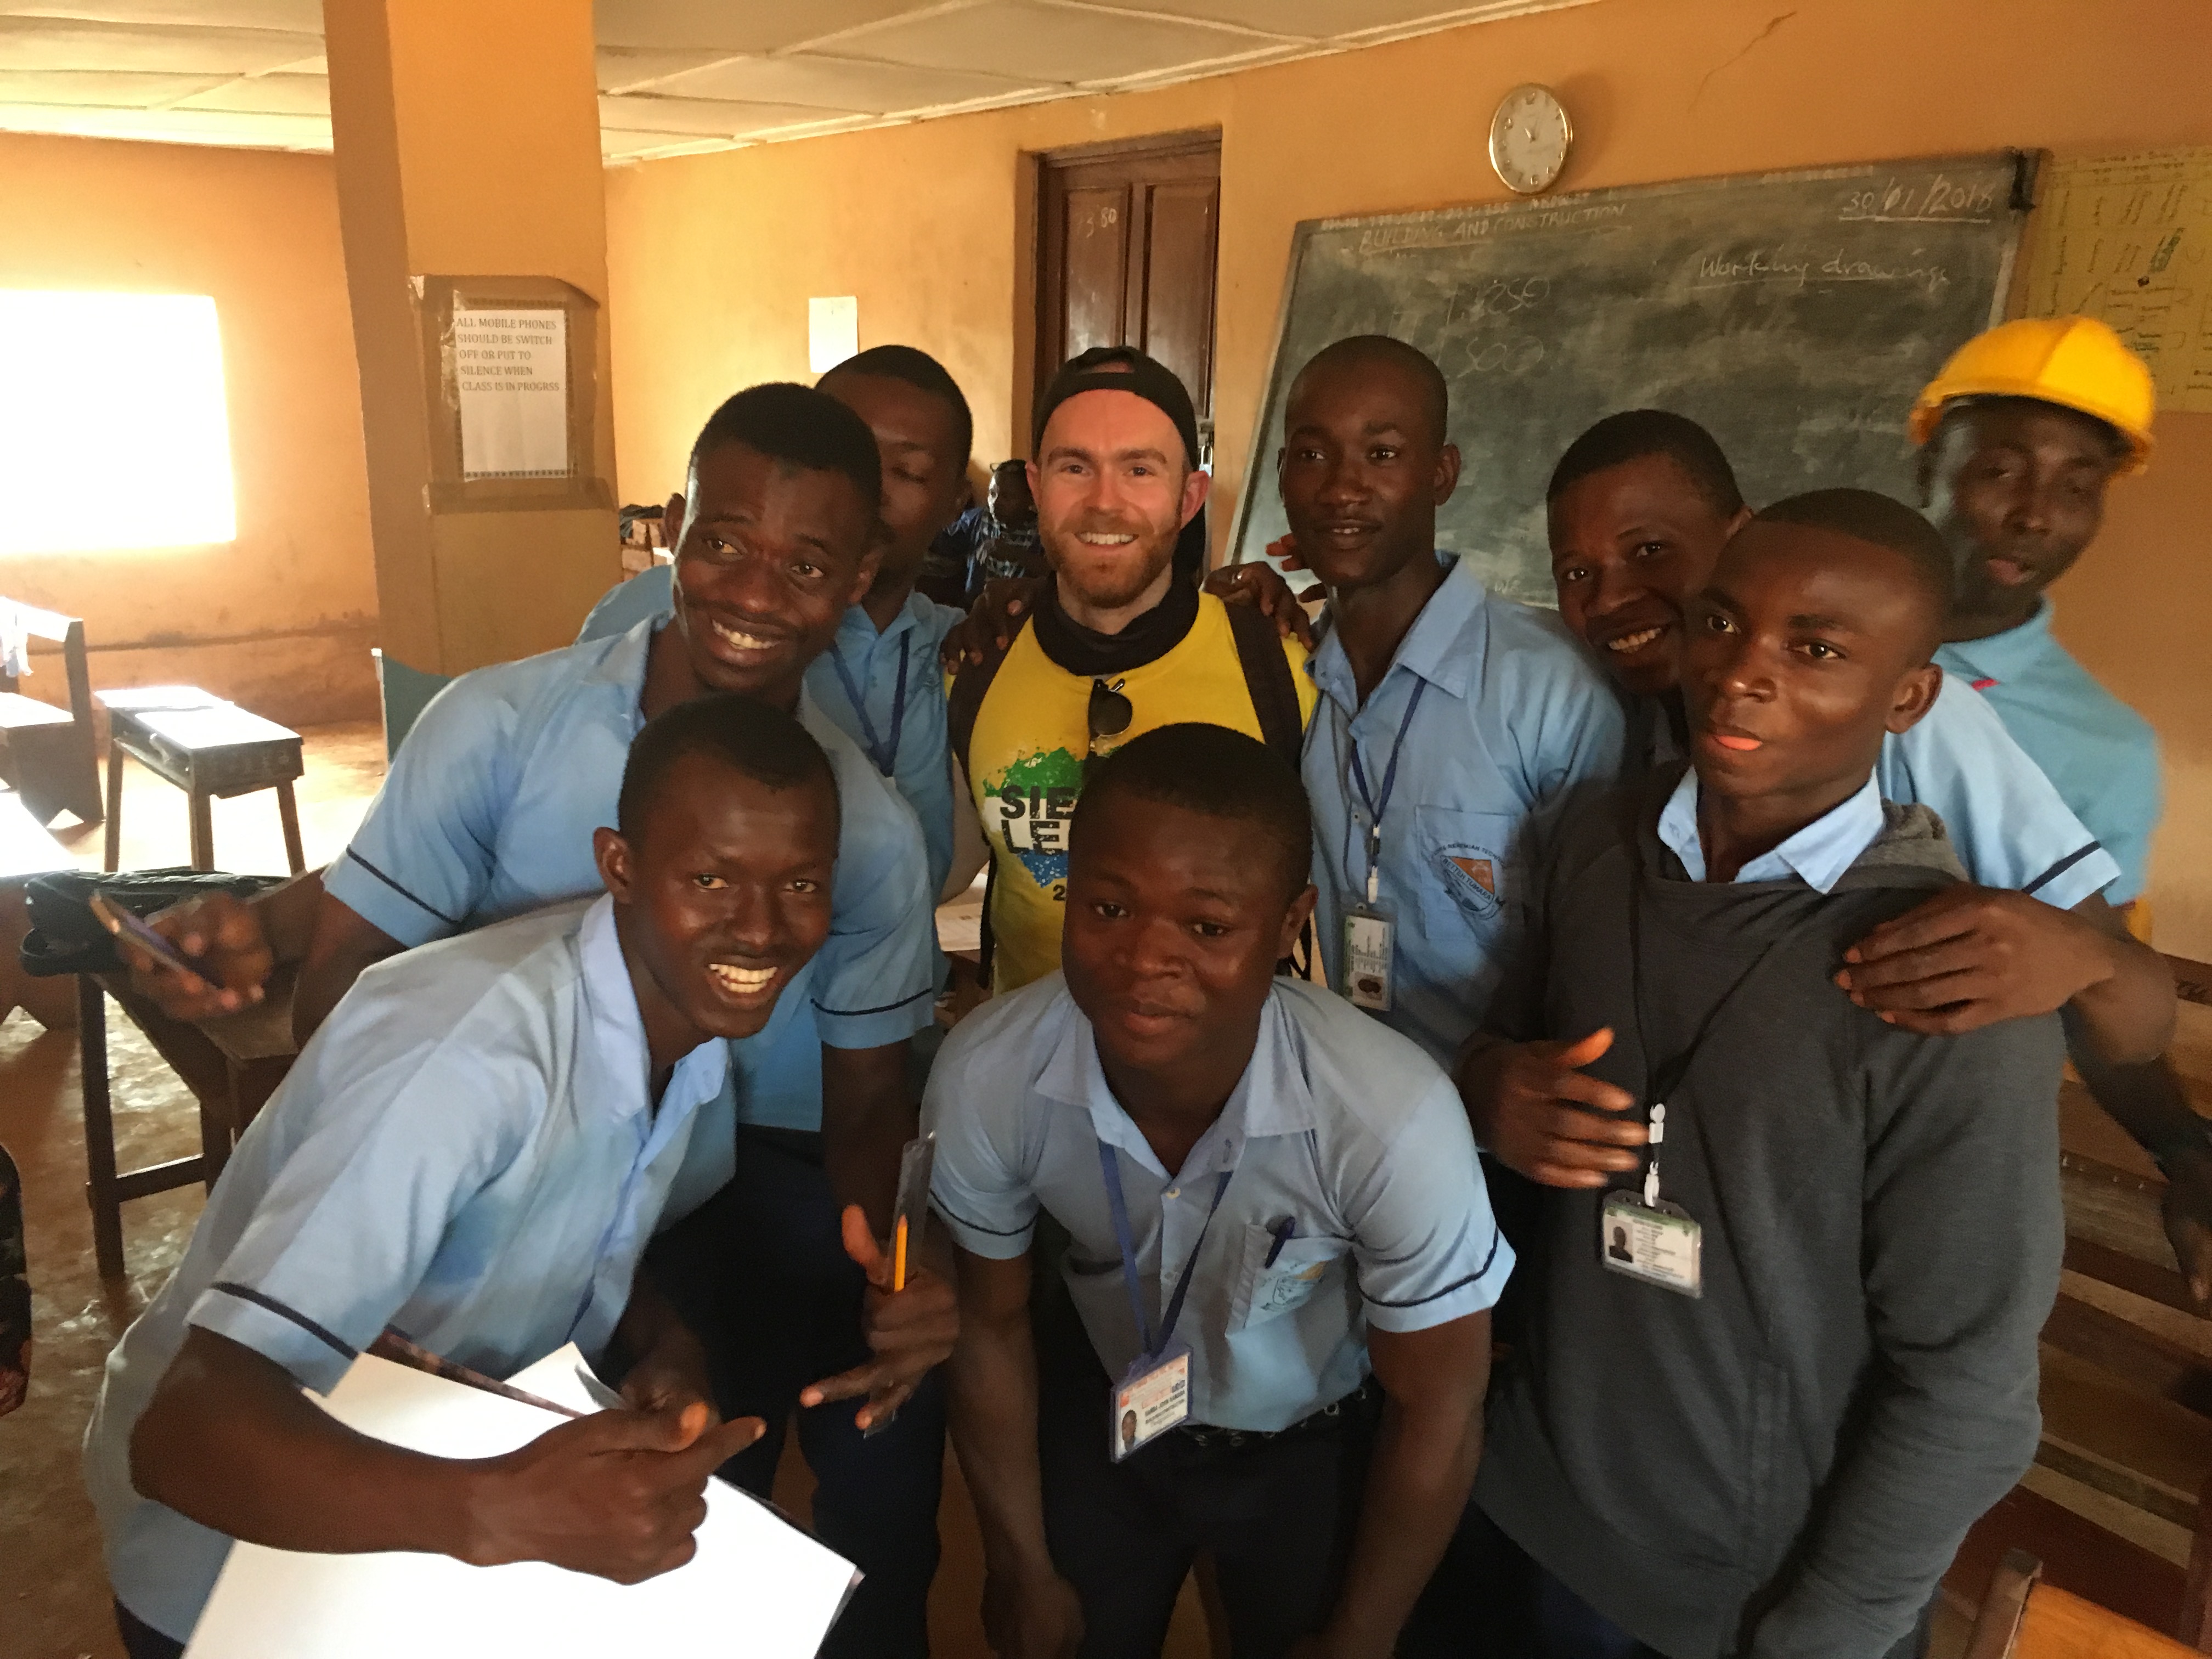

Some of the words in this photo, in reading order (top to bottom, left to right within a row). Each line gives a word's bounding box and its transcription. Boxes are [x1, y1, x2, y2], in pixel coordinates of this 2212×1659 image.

[1454, 217, 1489, 240] AND
[456, 318, 476, 328] ALL
[478, 318, 516, 329] MOBILE
[518, 319, 557, 330] PHONES
[458, 334, 499, 344] SHOULD
[501, 334, 513, 345] BE
[515, 335, 552, 345] SWITCH
[459, 349, 479, 359] OFF
[481, 349, 495, 359] OR
[497, 349, 516, 360] PUT
[517, 350, 532, 360] TO
[460, 365, 502, 375] SILENCE
[504, 366, 533, 375] WHEN
[462, 382, 492, 391] CLASS
[495, 382, 504, 391] IS
[505, 382, 516, 391] IN
[517, 382, 560, 392] PROGRSS
[1001, 819, 1063, 856] LE
